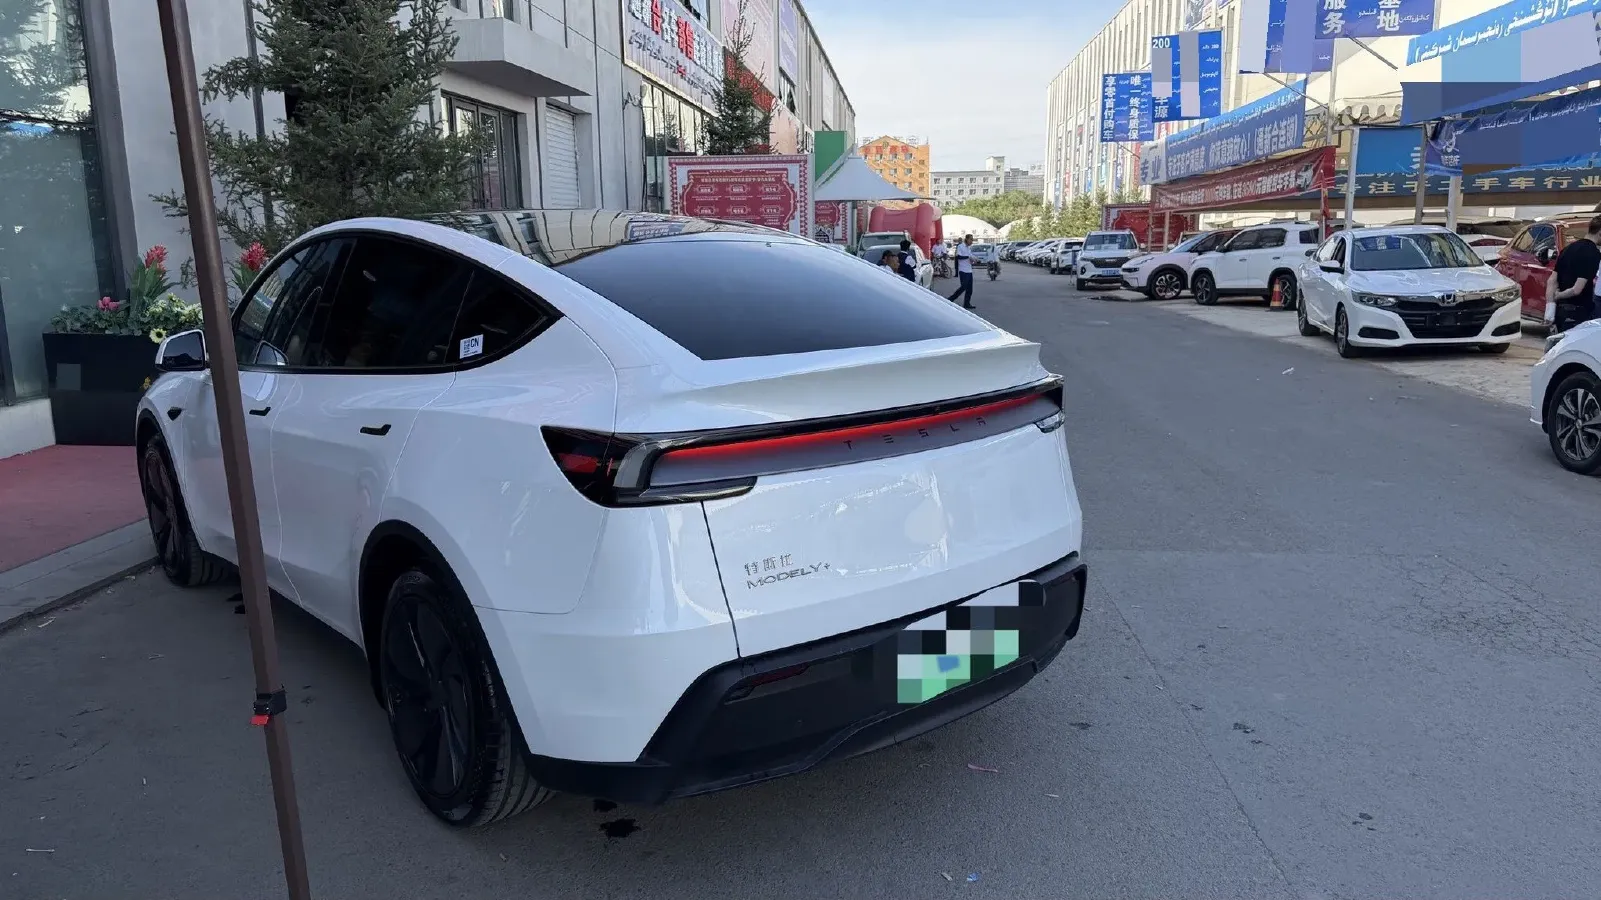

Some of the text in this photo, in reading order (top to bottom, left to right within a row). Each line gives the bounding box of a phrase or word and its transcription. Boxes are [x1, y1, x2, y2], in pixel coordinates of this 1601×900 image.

[1152, 37, 1171, 49] 200
[1102, 75, 1117, 141] 享零首付购车
[1127, 74, 1142, 141] 唯一终身质保
[1139, 155, 1162, 183] 专业
[470, 338, 479, 347] CN
[843, 415, 987, 450] TESLA
